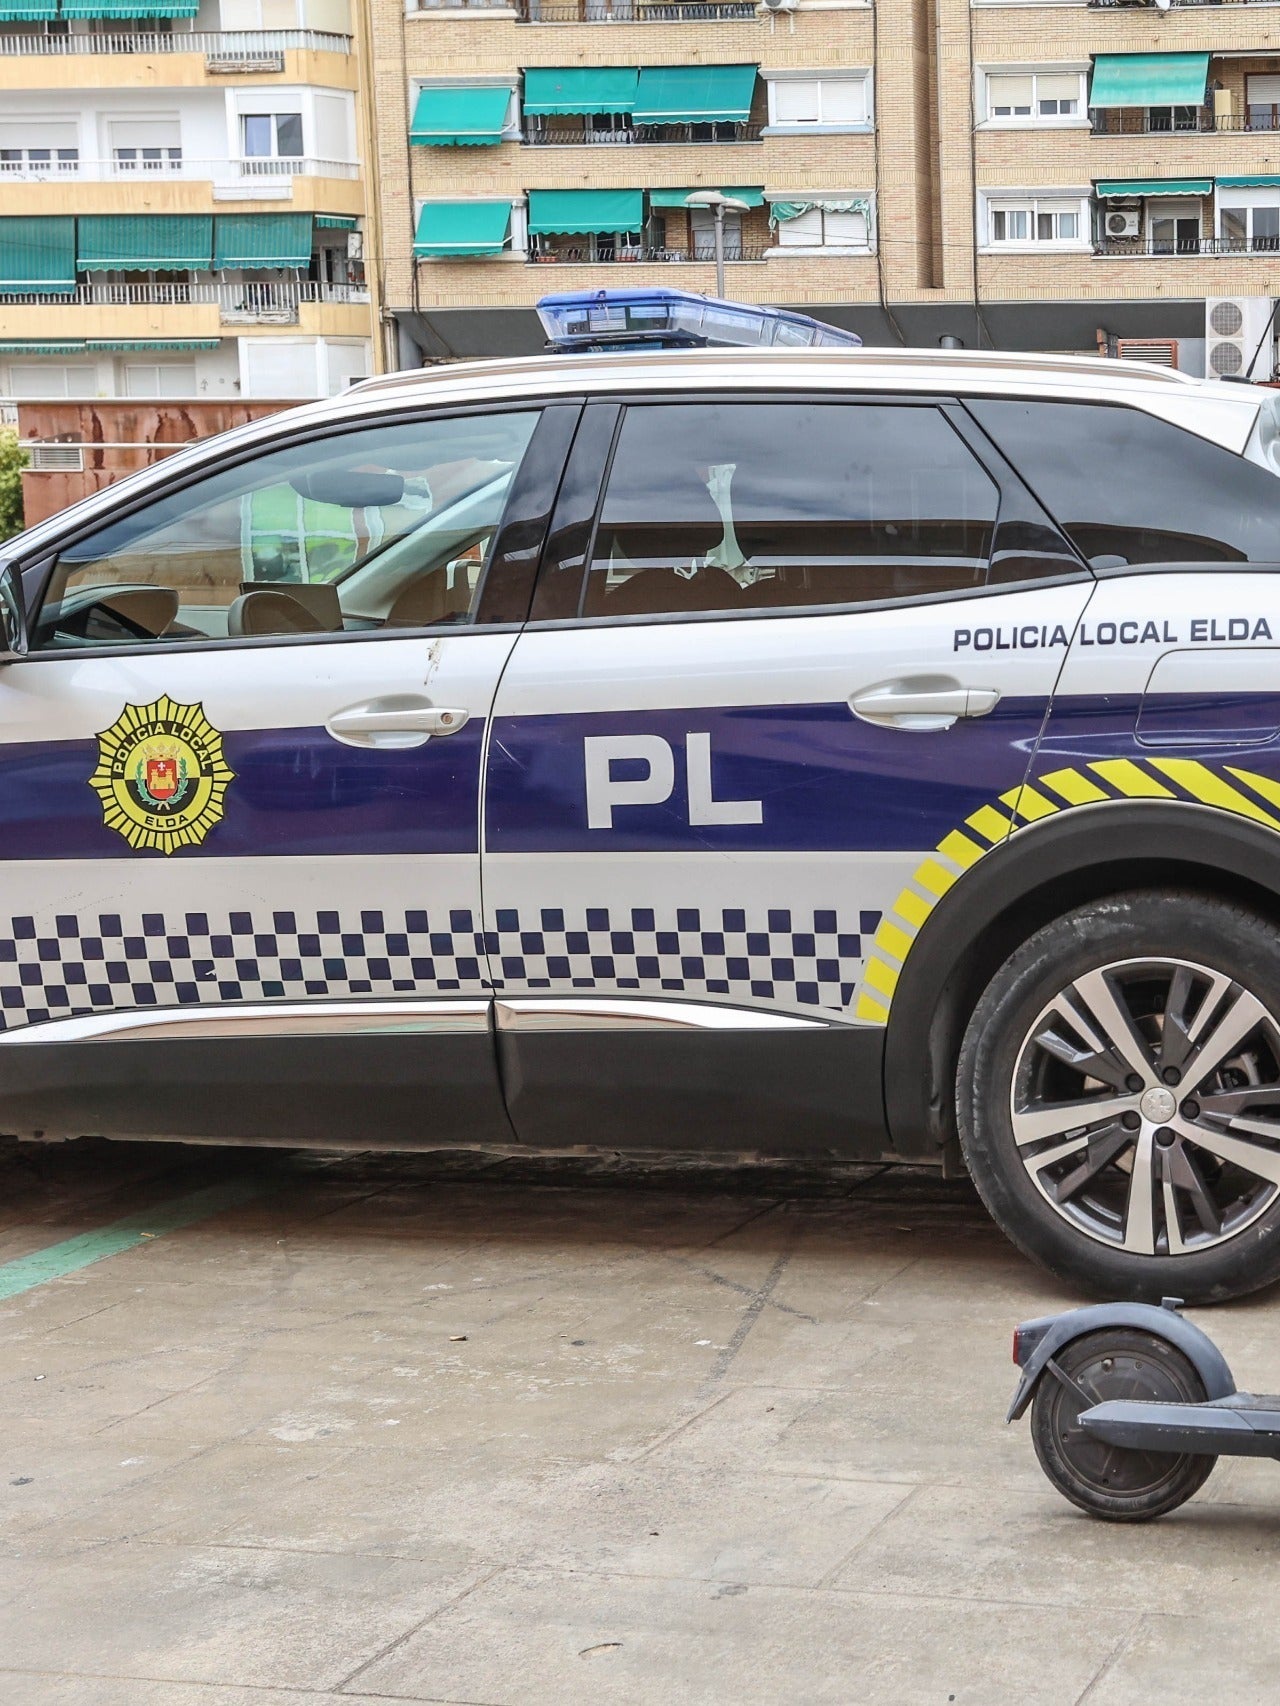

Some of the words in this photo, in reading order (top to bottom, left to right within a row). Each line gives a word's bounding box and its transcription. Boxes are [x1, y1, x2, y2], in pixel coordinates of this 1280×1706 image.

[953, 624, 1069, 651] POLICIA
[1080, 620, 1178, 646] LOCAL
[1190, 618, 1273, 642] ELDA
[113, 722, 165, 773] POLICIA
[171, 723, 211, 770] LOCAL
[584, 732, 763, 829] PL
[145, 814, 189, 828] ELDA
